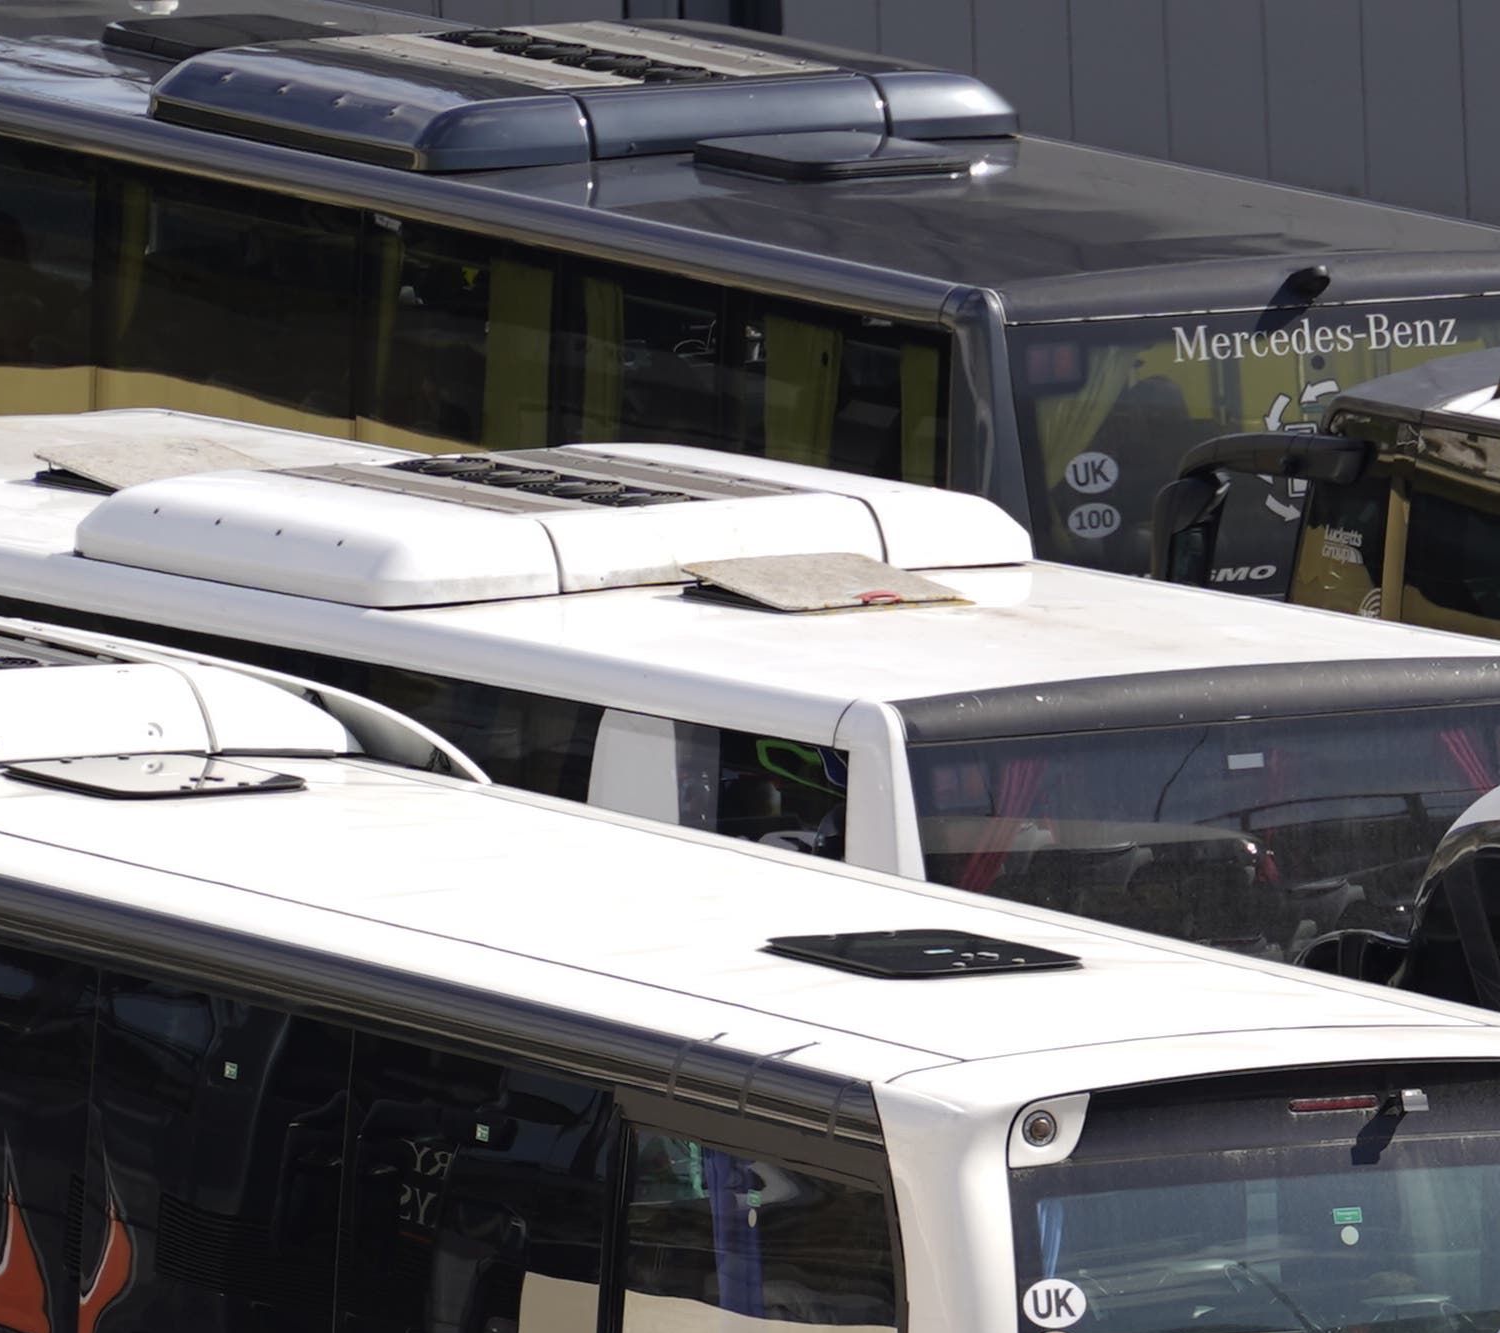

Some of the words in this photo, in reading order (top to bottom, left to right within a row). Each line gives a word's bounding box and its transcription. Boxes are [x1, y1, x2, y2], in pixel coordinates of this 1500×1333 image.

[1173, 312, 1458, 364] Mercedes-Benz
[1072, 464, 1107, 489] UK
[1077, 510, 1111, 532] 100
[1324, 525, 1363, 546] Lucketts
[1034, 1290, 1076, 1318] UK
